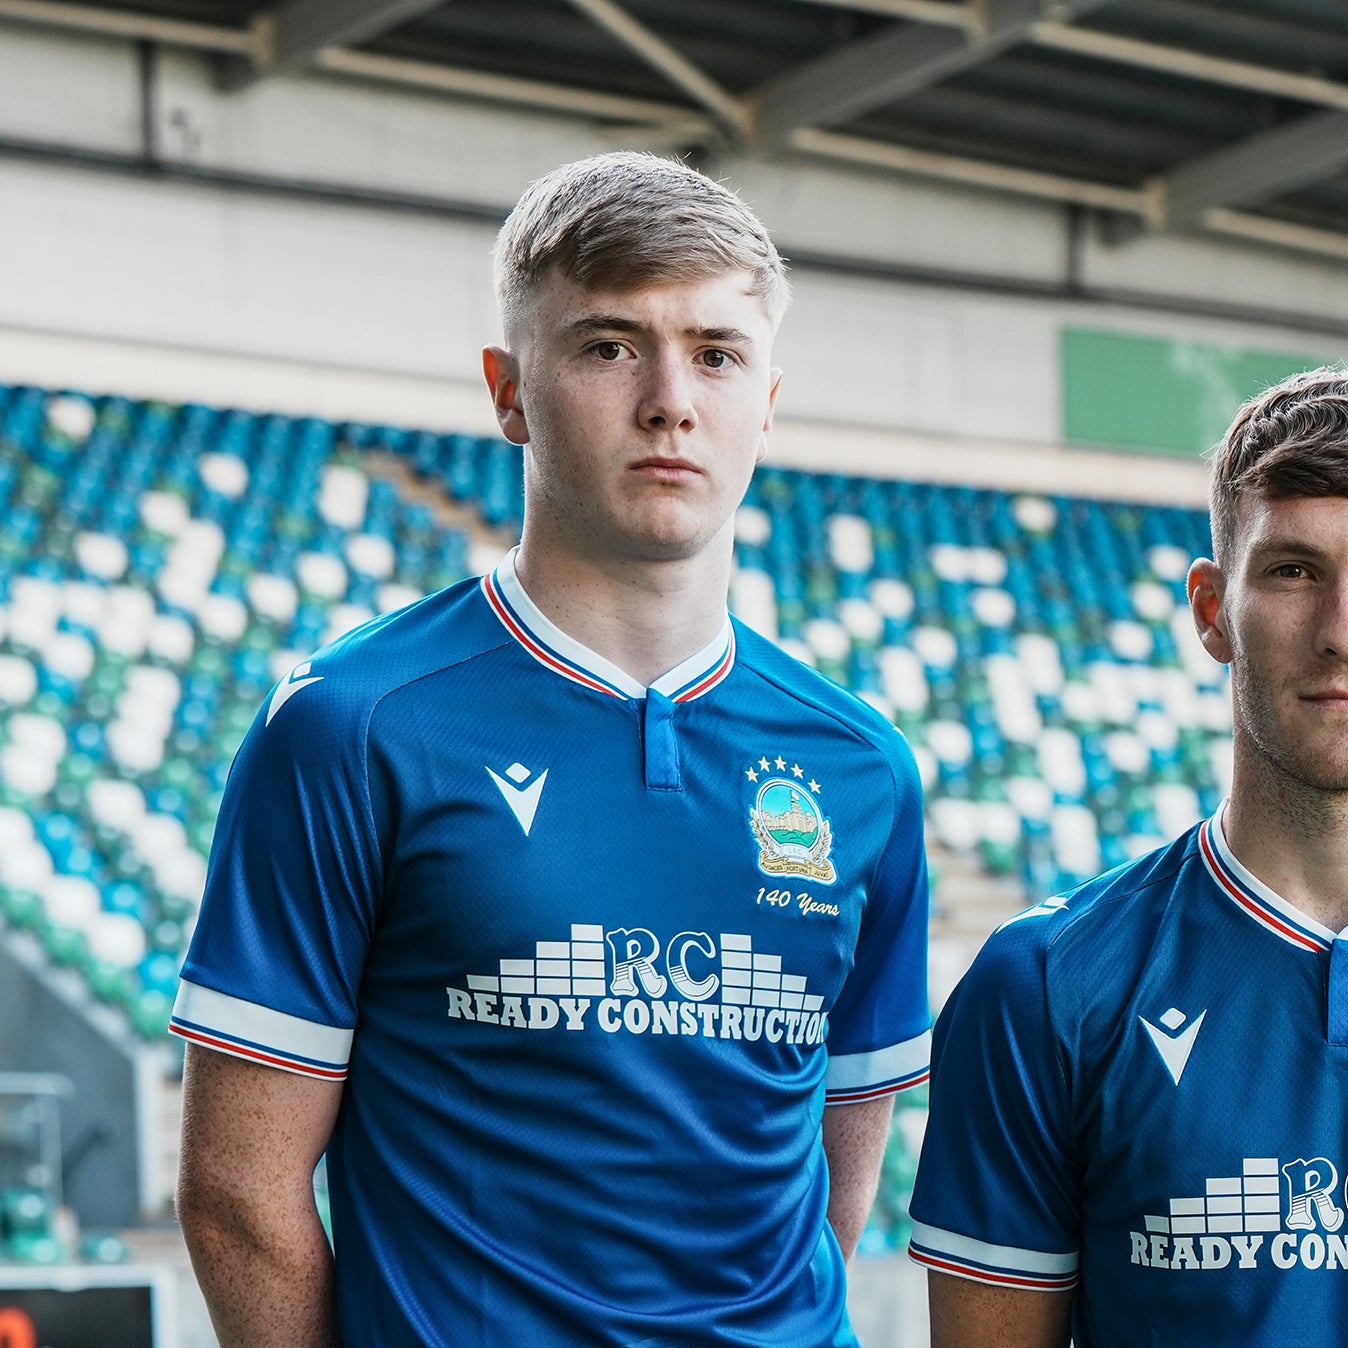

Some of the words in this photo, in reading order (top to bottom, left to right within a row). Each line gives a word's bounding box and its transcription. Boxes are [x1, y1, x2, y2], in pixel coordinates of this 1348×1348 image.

[756, 887, 791, 907] 140
[796, 893, 840, 916] Years
[606, 927, 720, 1000] RC
[446, 987, 591, 1031] READY
[1129, 1231, 1264, 1270] READY
